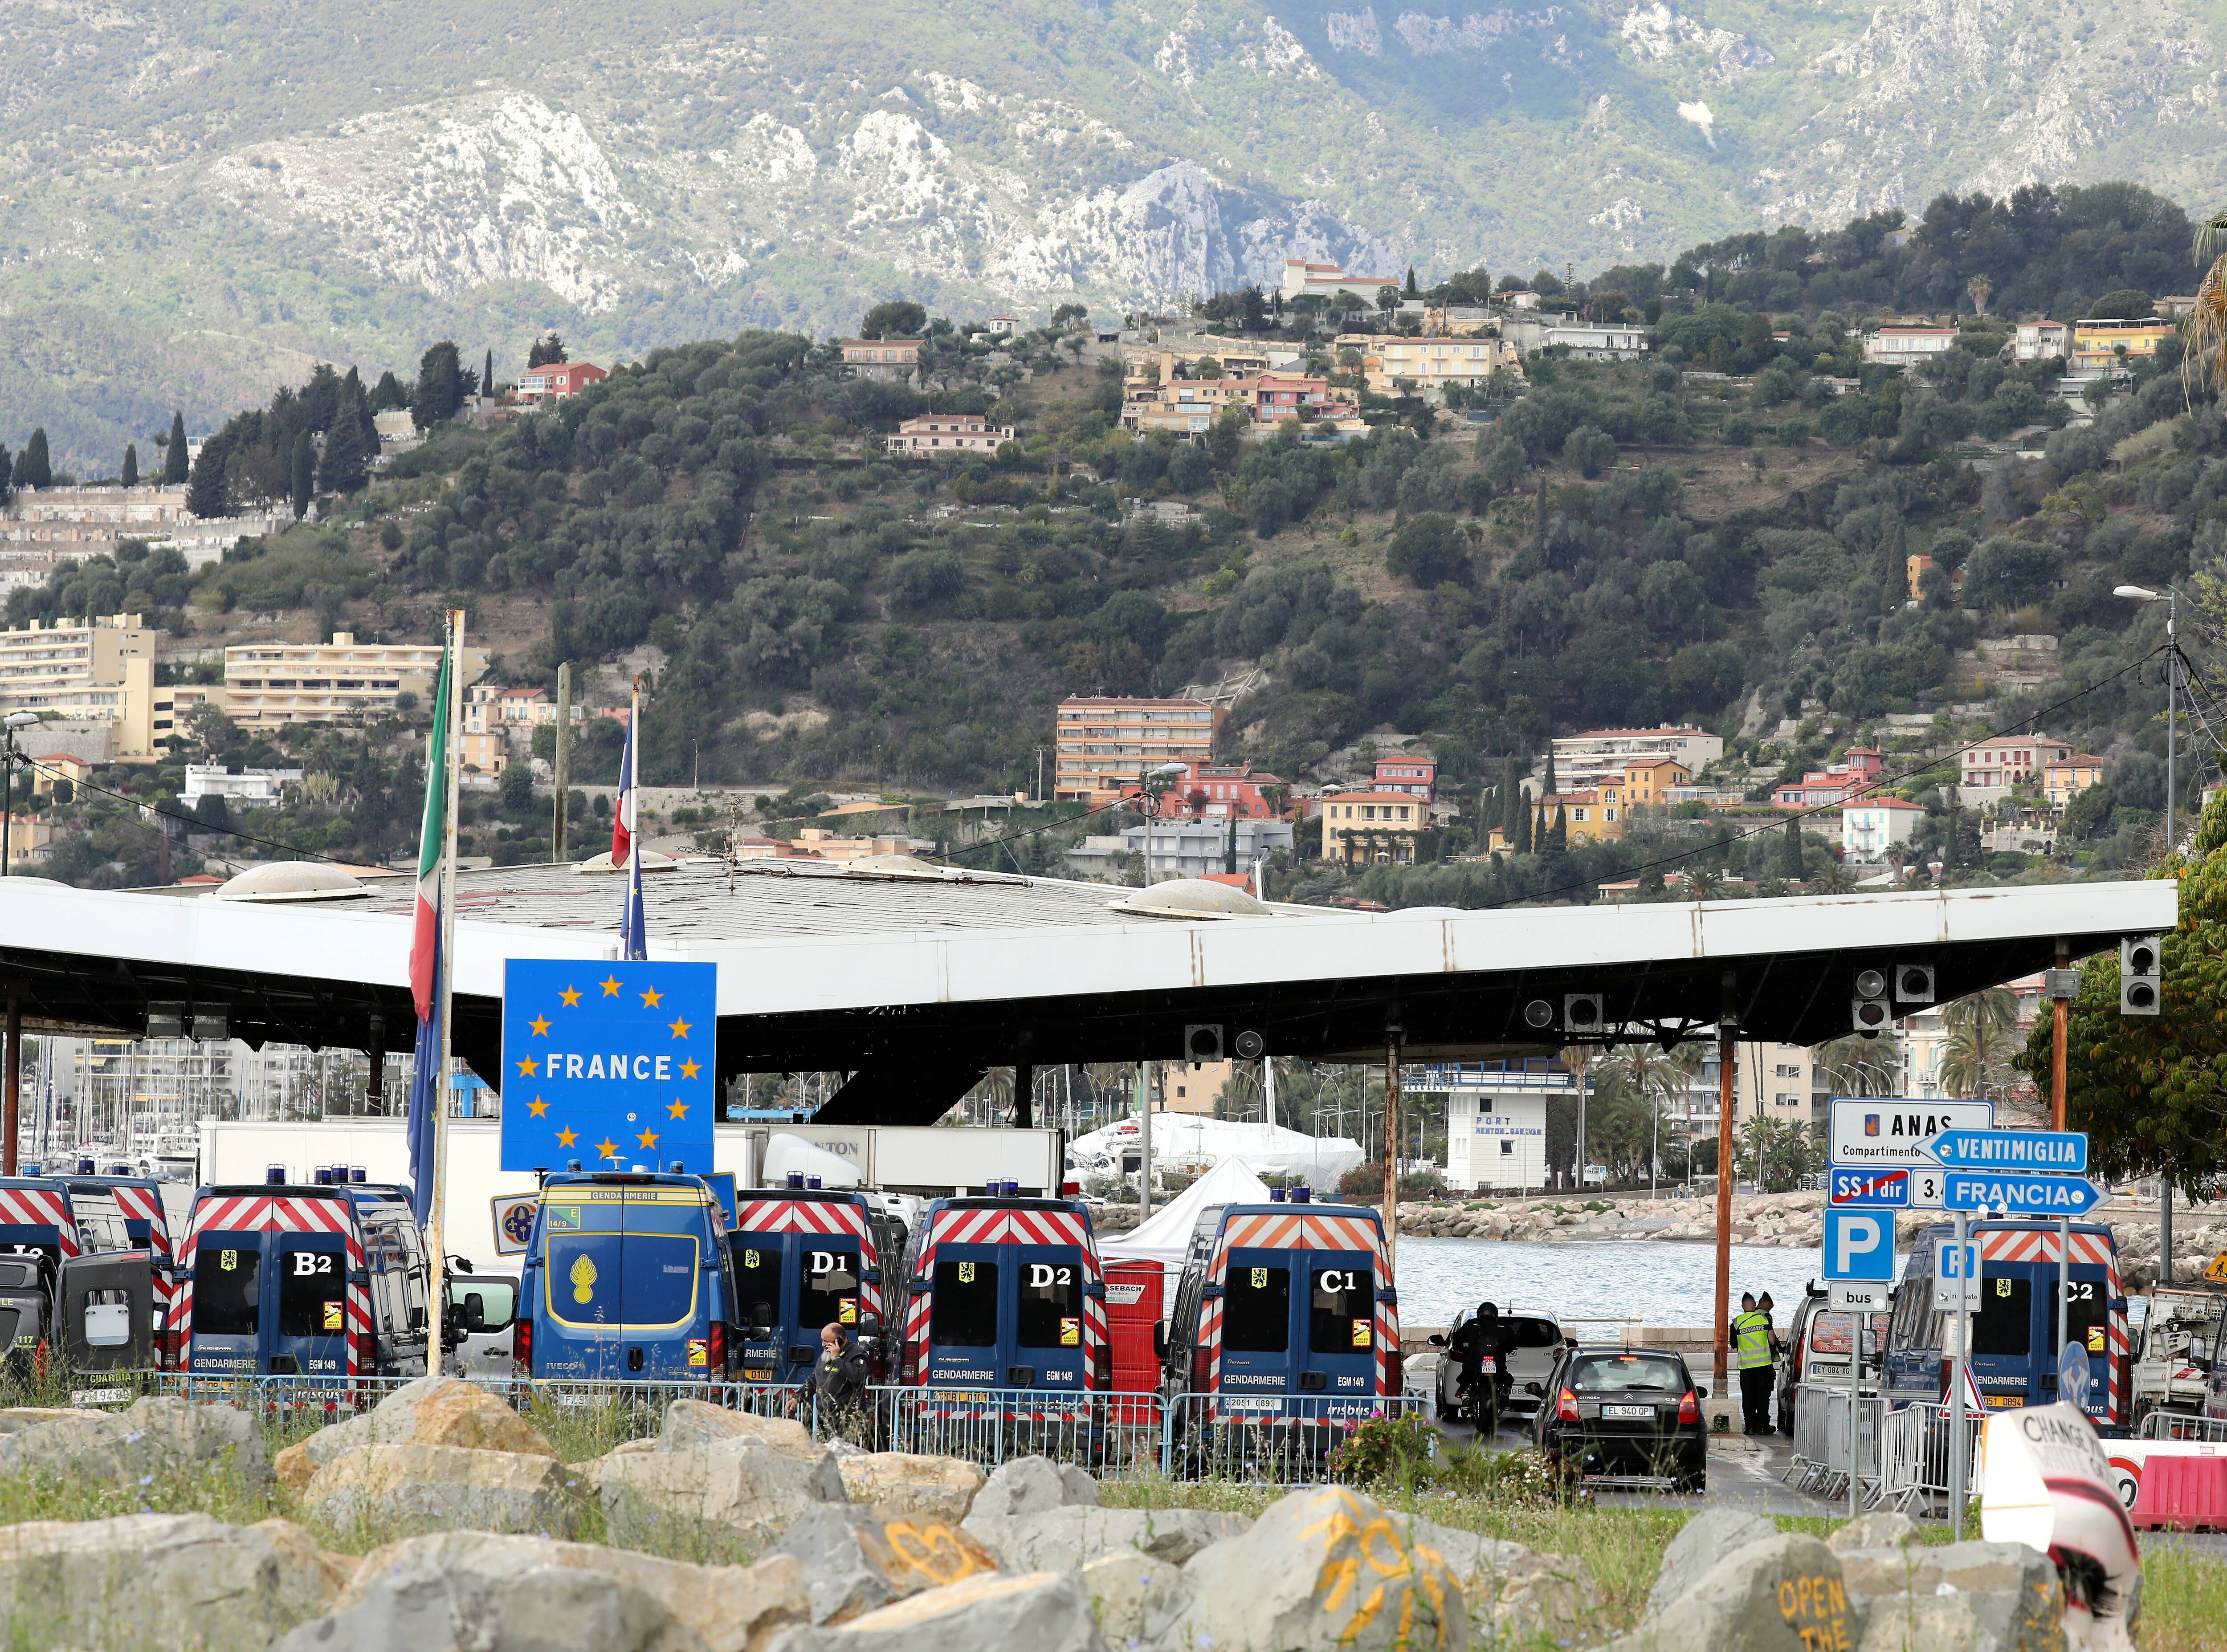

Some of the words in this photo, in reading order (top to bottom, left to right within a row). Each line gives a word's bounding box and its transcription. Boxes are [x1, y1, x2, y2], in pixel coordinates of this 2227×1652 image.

[547, 1054, 670, 1080] FRANCE
[1477, 1117, 1510, 1125] PORT
[1891, 1115, 1951, 1136] ANAS
[1843, 1145, 1920, 1158] Compartimento
[1957, 1138, 2076, 1163] VENTIMIGLIA
[1838, 1176, 1862, 1197] SS
[1867, 1176, 1874, 1197] 1
[1880, 1180, 1902, 1198] dir
[1956, 1182, 2071, 1205] FRANCIA
[571, 1208, 577, 1217] E
[1837, 1216, 1880, 1272] P
[294, 1252, 331, 1275] B2
[811, 1251, 847, 1273] D1
[1030, 1264, 1071, 1287] D2
[1320, 1270, 1356, 1293] C1
[1847, 1291, 1871, 1303] bus
[2058, 1281, 2093, 1302] C2
[1740, 1325, 1764, 1334] GENDARMERIE
[194, 1359, 256, 1368] GENDARMERIE
[309, 1359, 322, 1370] EGM
[324, 1359, 335, 1370] 14/9
[90, 1373, 131, 1383] GUARDIA
[751, 1370, 770, 1379] 0100
[932, 1370, 994, 1380] GENDARMERIE
[1046, 1371, 1060, 1381] EGM
[1061, 1371, 1073, 1381] 14/9
[1224, 1375, 1285, 1385] GENDARMERIE
[1338, 1376, 1351, 1386] EGM
[1352, 1377, 1364, 1387] 14/9
[2003, 1398, 2021, 1406] 0894
[1608, 1407, 1649, 1415] EL-940-QP
[1779, 1575, 1845, 1620] OPEN
[1799, 1618, 1851, 1652] THE
